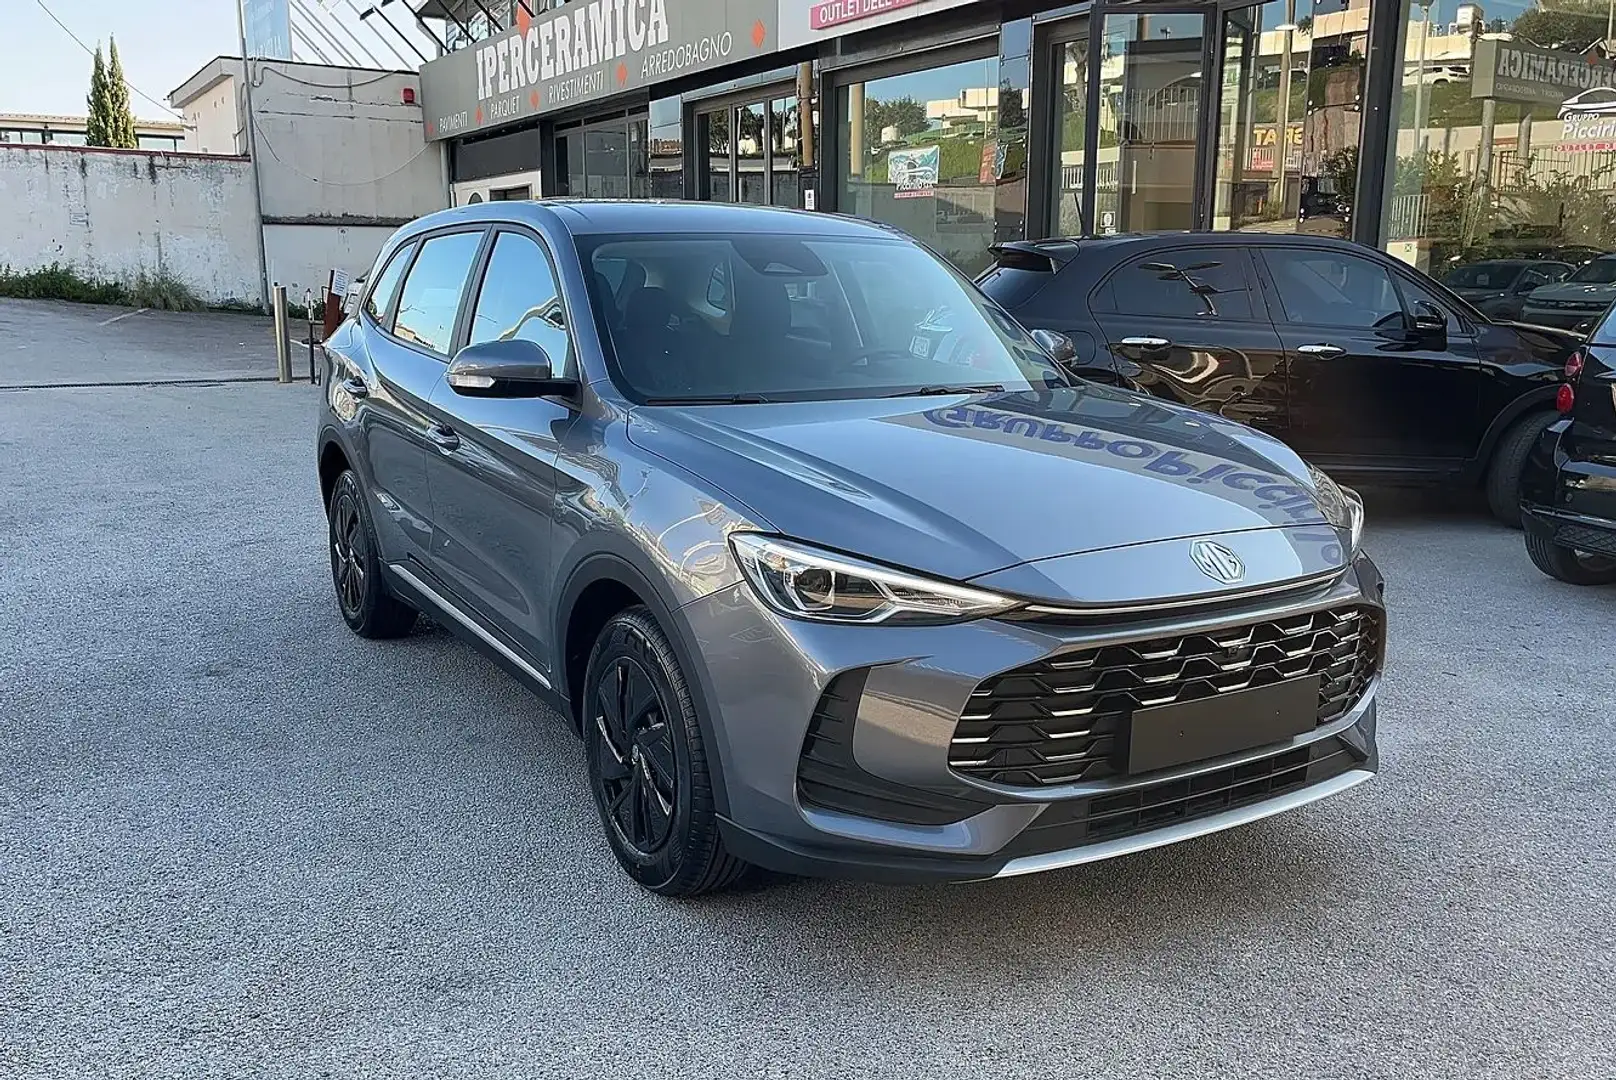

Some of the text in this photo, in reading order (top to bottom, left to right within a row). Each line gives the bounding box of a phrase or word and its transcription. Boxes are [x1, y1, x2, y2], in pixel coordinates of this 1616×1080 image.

[819, 0, 861, 23] OUTLET
[476, 0, 669, 100] IPERCERAMICA
[490, 96, 520, 119] PARQUET
[548, 70, 604, 104] RIVESTIMENTI
[640, 31, 733, 79] ARREDOBAGNO
[1563, 111, 1600, 123] GRUPPO
[1193, 541, 1242, 580] MG
